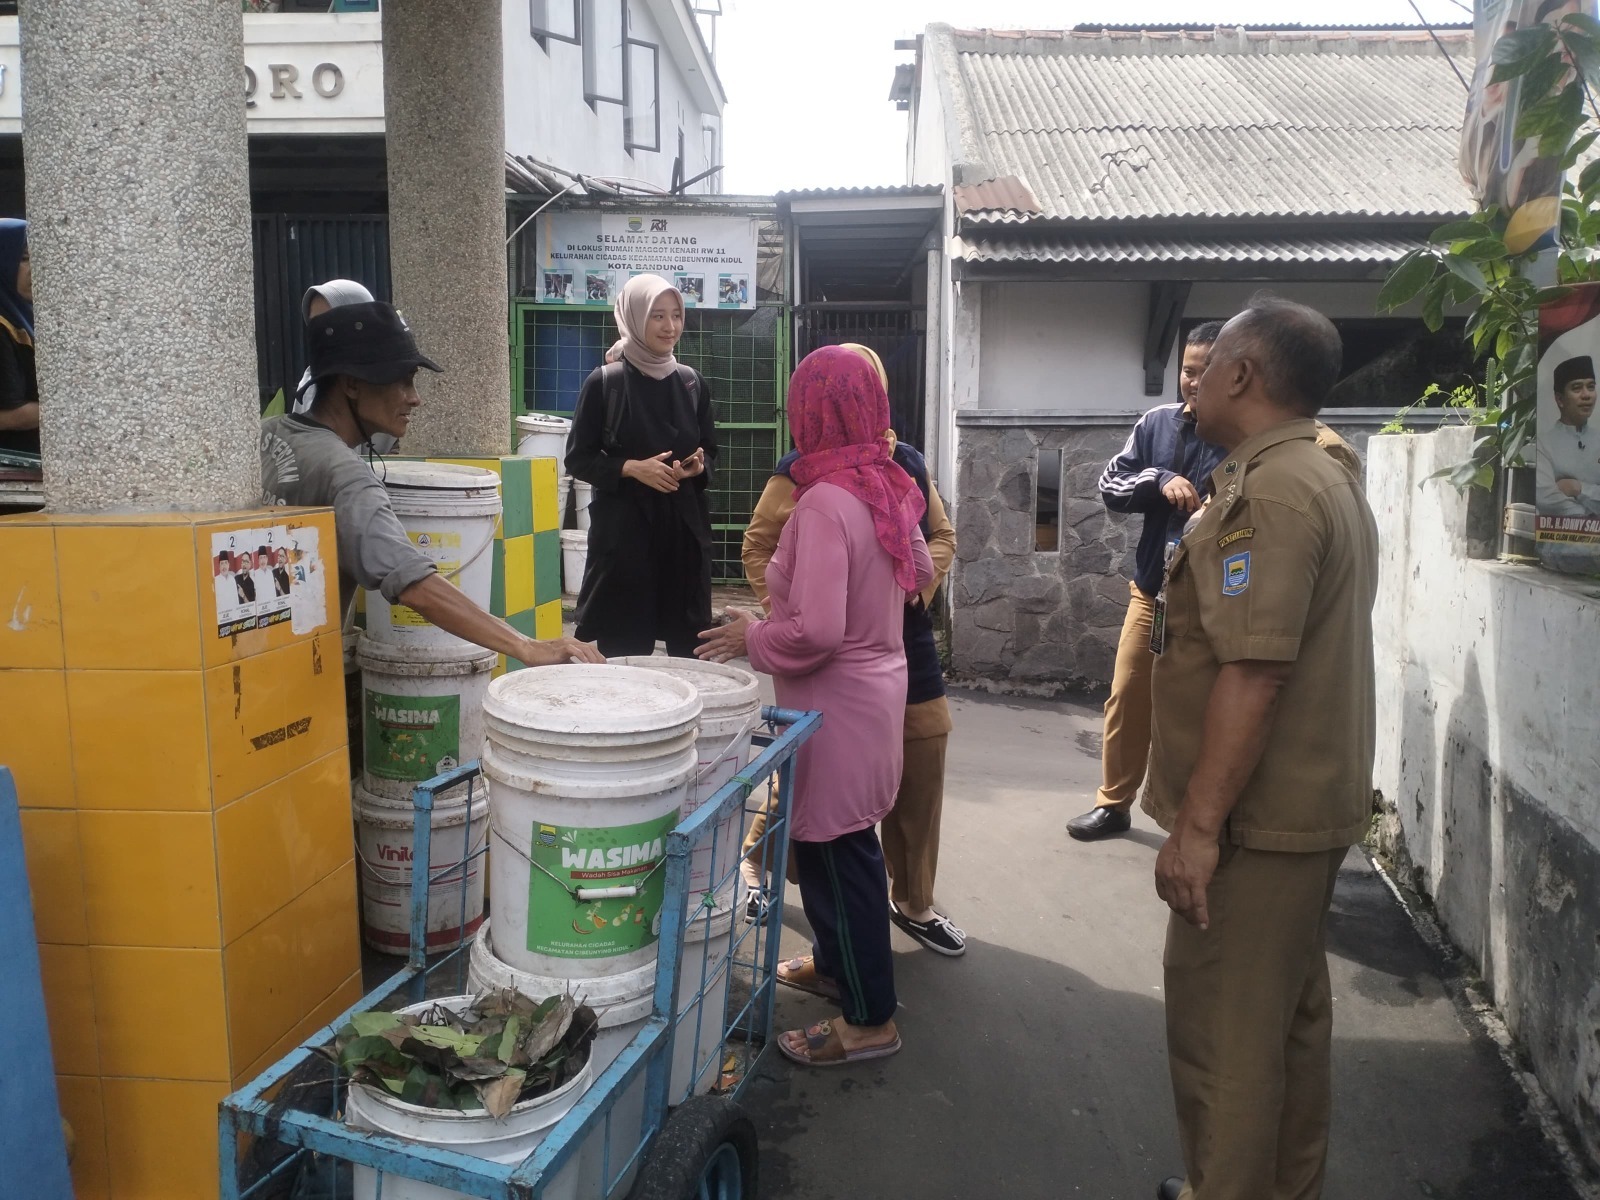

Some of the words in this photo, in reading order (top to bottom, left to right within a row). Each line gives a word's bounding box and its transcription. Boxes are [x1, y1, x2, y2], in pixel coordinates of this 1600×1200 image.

[596, 234, 650, 244] SELAMAT
[651, 235, 698, 245] DATANG
[550, 252, 594, 260] KELURAHAN
[595, 253, 627, 261] CICADAS
[628, 254, 673, 262] KECAMATAN
[607, 262, 633, 270] KOTA
[635, 263, 684, 271] BANDUNG
[1540, 517, 1554, 529] DR.
[229, 536, 236, 548] 2
[267, 531, 273, 543] 2
[375, 705, 440, 724] WASIMA
[562, 837, 662, 869] WASIMA
[621, 865, 648, 876] Makanan
[536, 945, 574, 955] KECAMATAN
[612, 945, 629, 953] KIDUL
[551, 940, 588, 949] KELURAHAN
